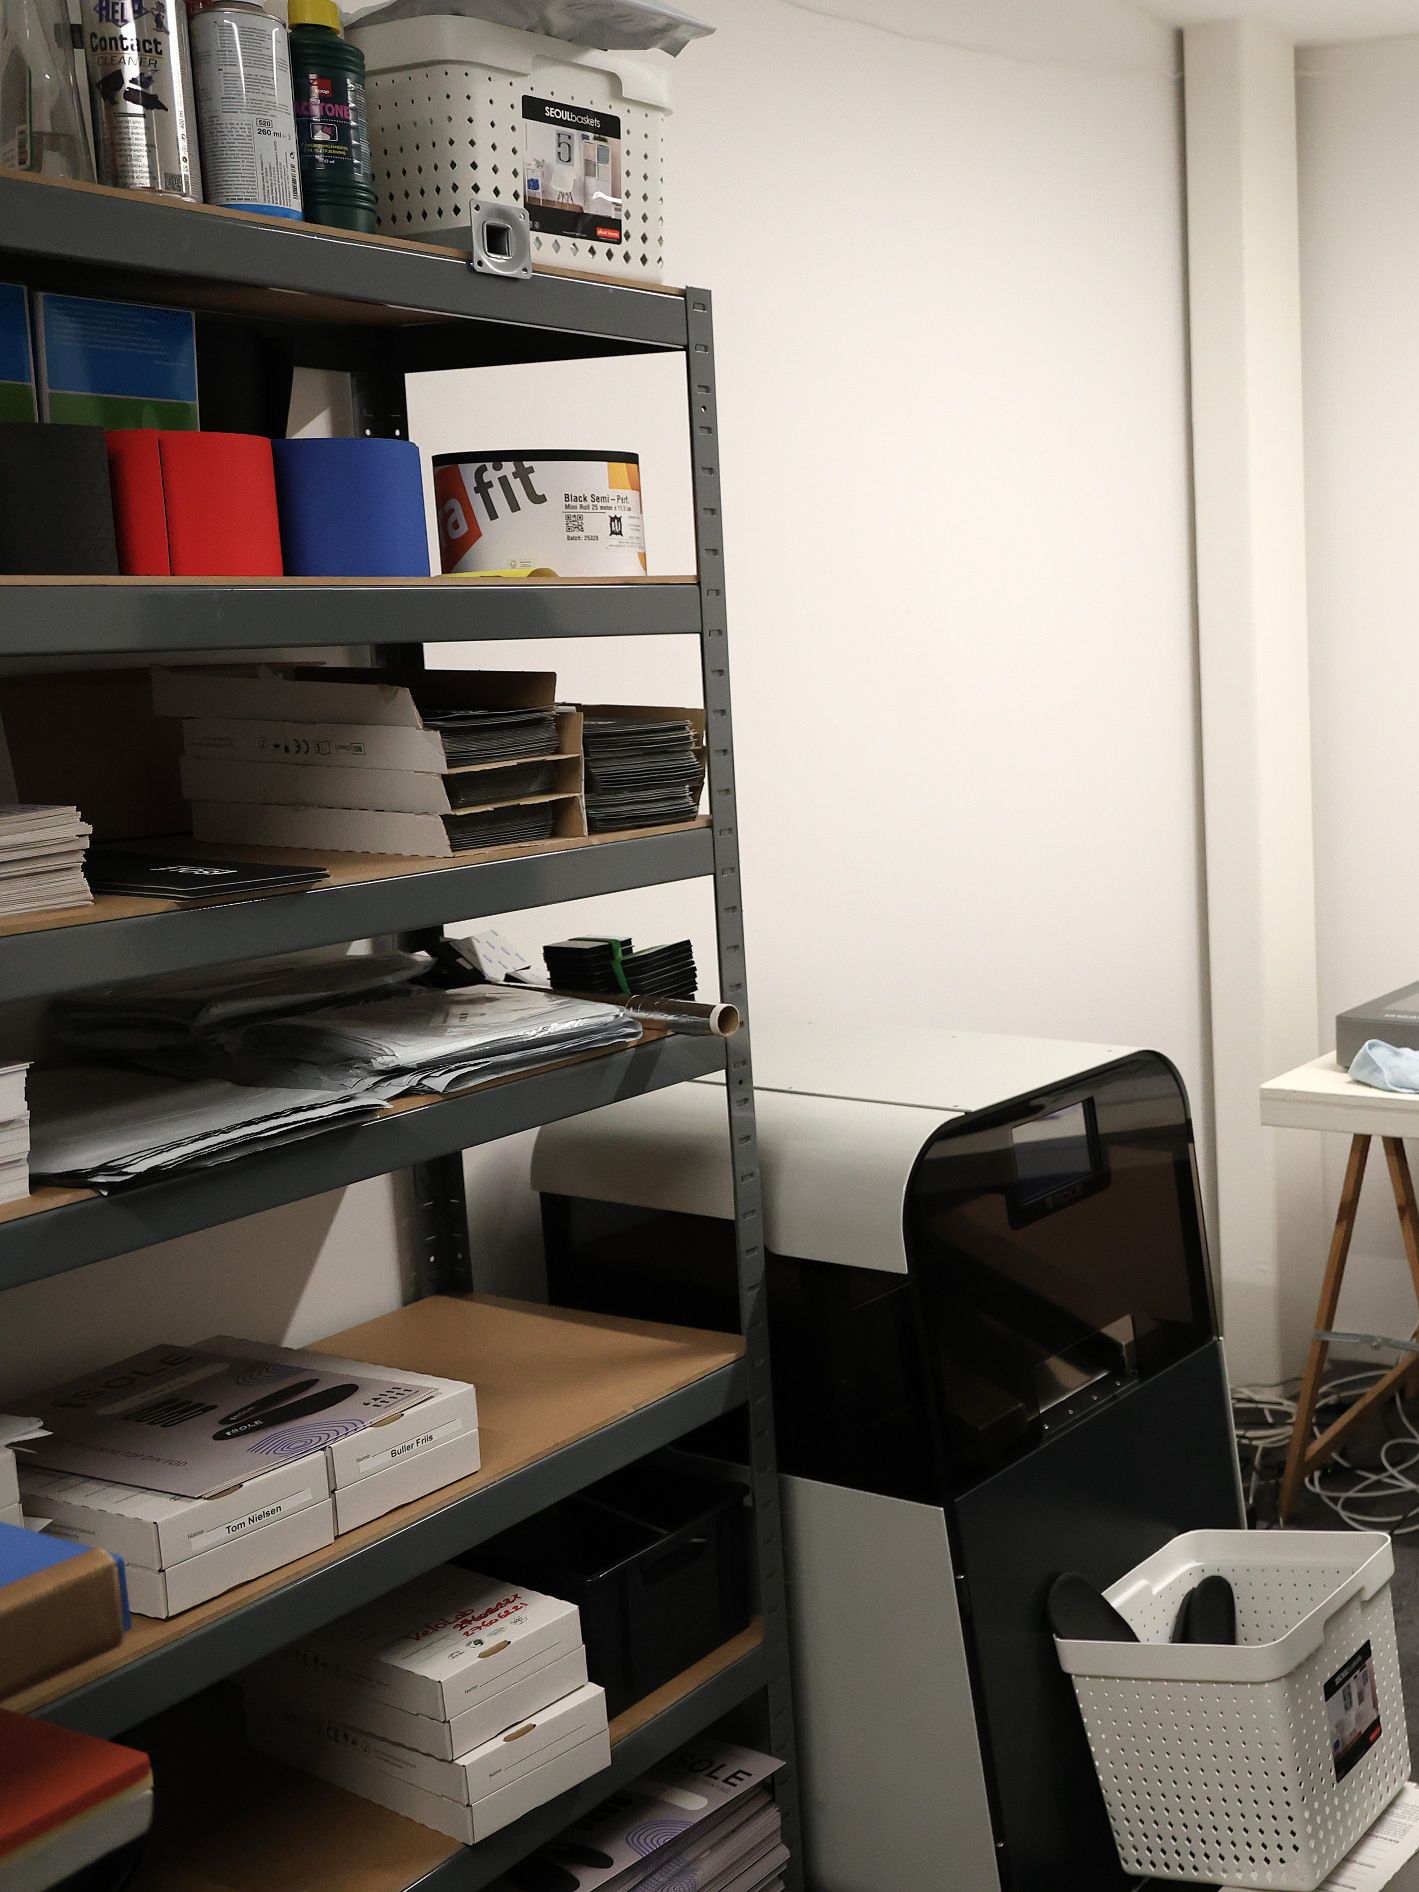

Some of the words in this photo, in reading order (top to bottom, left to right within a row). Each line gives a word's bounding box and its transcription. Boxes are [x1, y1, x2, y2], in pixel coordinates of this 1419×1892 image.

[90, 32, 163, 56] Contact
[97, 54, 158, 69] CLEANER
[258, 119, 271, 127] 520
[544, 106, 601, 128] SEOULbaskets
[257, 128, 272, 136] 260
[473, 461, 548, 522] fit
[563, 493, 588, 503] Black
[590, 493, 610, 504] Semi
[390, 1443, 415, 1458] Buller
[415, 1434, 434, 1447] Friis
[187, 1530, 205, 1540] Name
[225, 1522, 246, 1534] Tom
[248, 1505, 282, 1526] Nielsen
